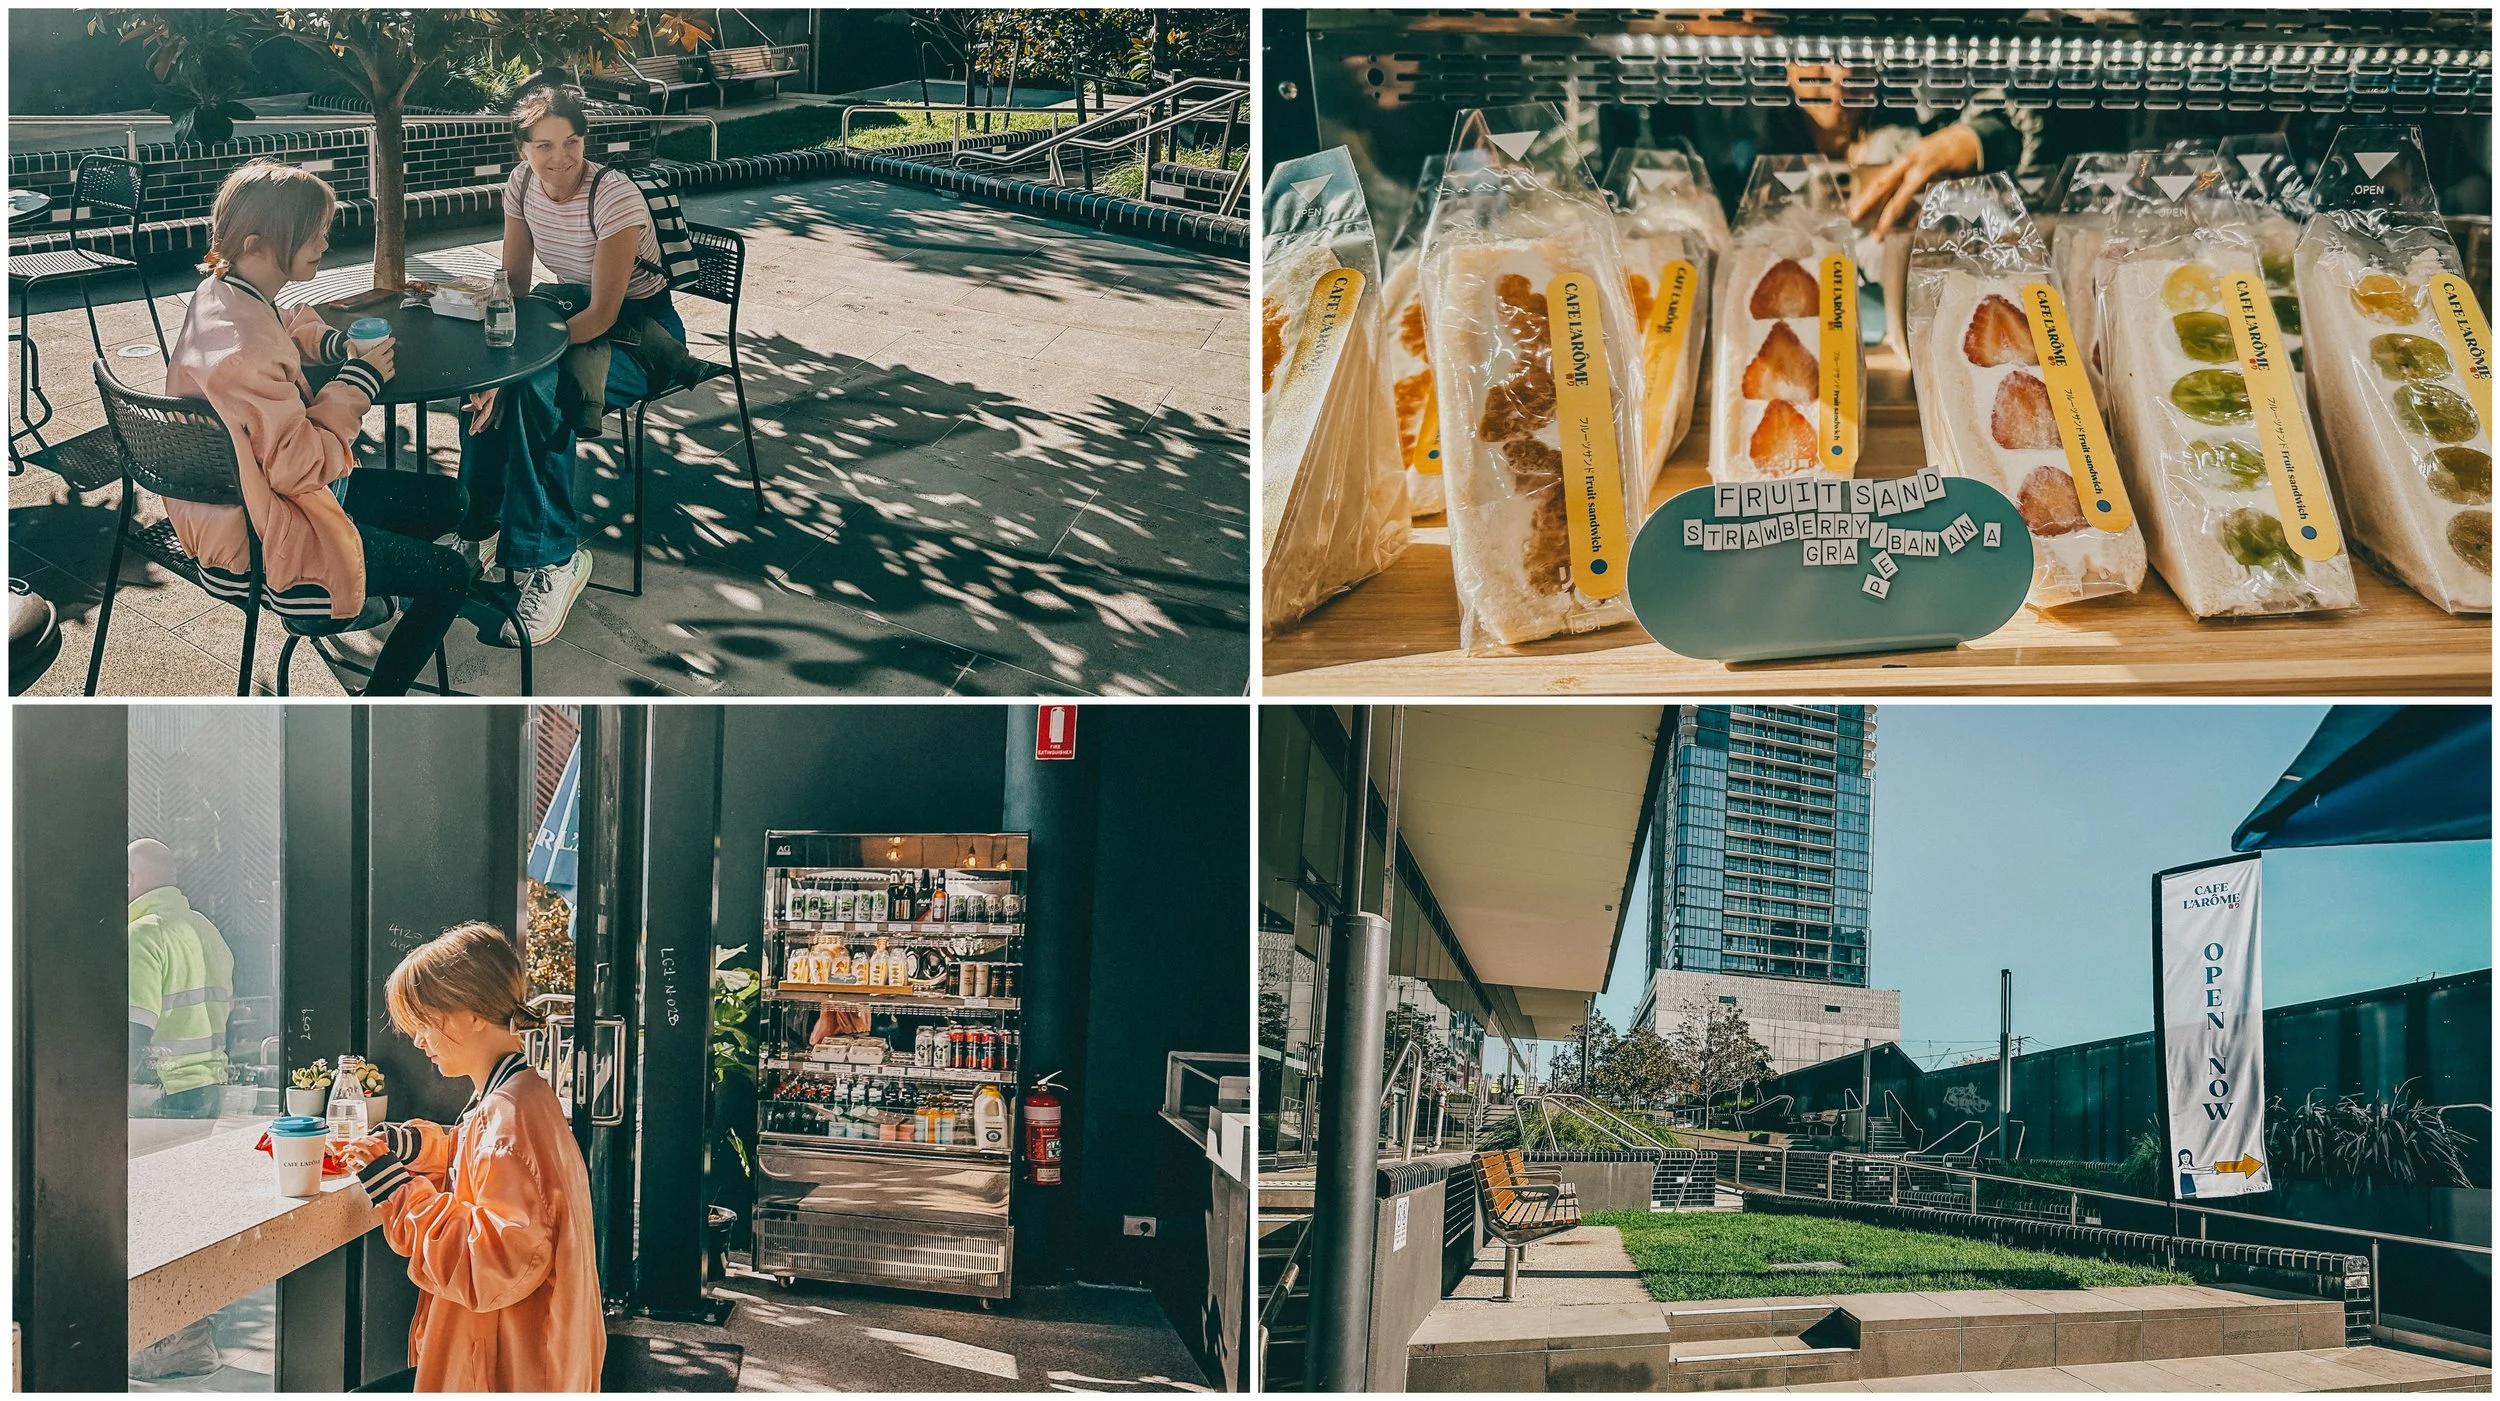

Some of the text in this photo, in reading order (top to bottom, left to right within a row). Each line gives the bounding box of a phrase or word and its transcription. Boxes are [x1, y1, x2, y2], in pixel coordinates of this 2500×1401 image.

[2354, 184, 2385, 195] OPEN
[1295, 207, 1322, 220] OPEN
[1958, 226, 1986, 239] OPEN
[1833, 261, 1843, 287] CAFE
[1326, 276, 1349, 311] CAFE
[1564, 281, 1591, 387] CAFE L'ARÔME
[2036, 290, 2068, 367] CAFE L'ARÔME
[2236, 280, 2270, 371] CAFE L'ARÔME
[2443, 282, 2492, 380] CAFE L'ARÔME
[2077, 433, 2091, 453] Fruit
[1584, 475, 1597, 500] Fruit
[1720, 473, 1941, 509] FRUIT SAND
[2083, 453, 2104, 495] sandwich
[2280, 450, 2294, 472] Fruit
[2287, 472, 2308, 520] sandwich
[1587, 502, 1602, 553] sandwich
[2183, 893, 2241, 909] L'ARÔME
[2194, 882, 2229, 895] CAFE
[2203, 942, 2225, 1030] OPEN
[2202, 1056, 2234, 1122] NOW
